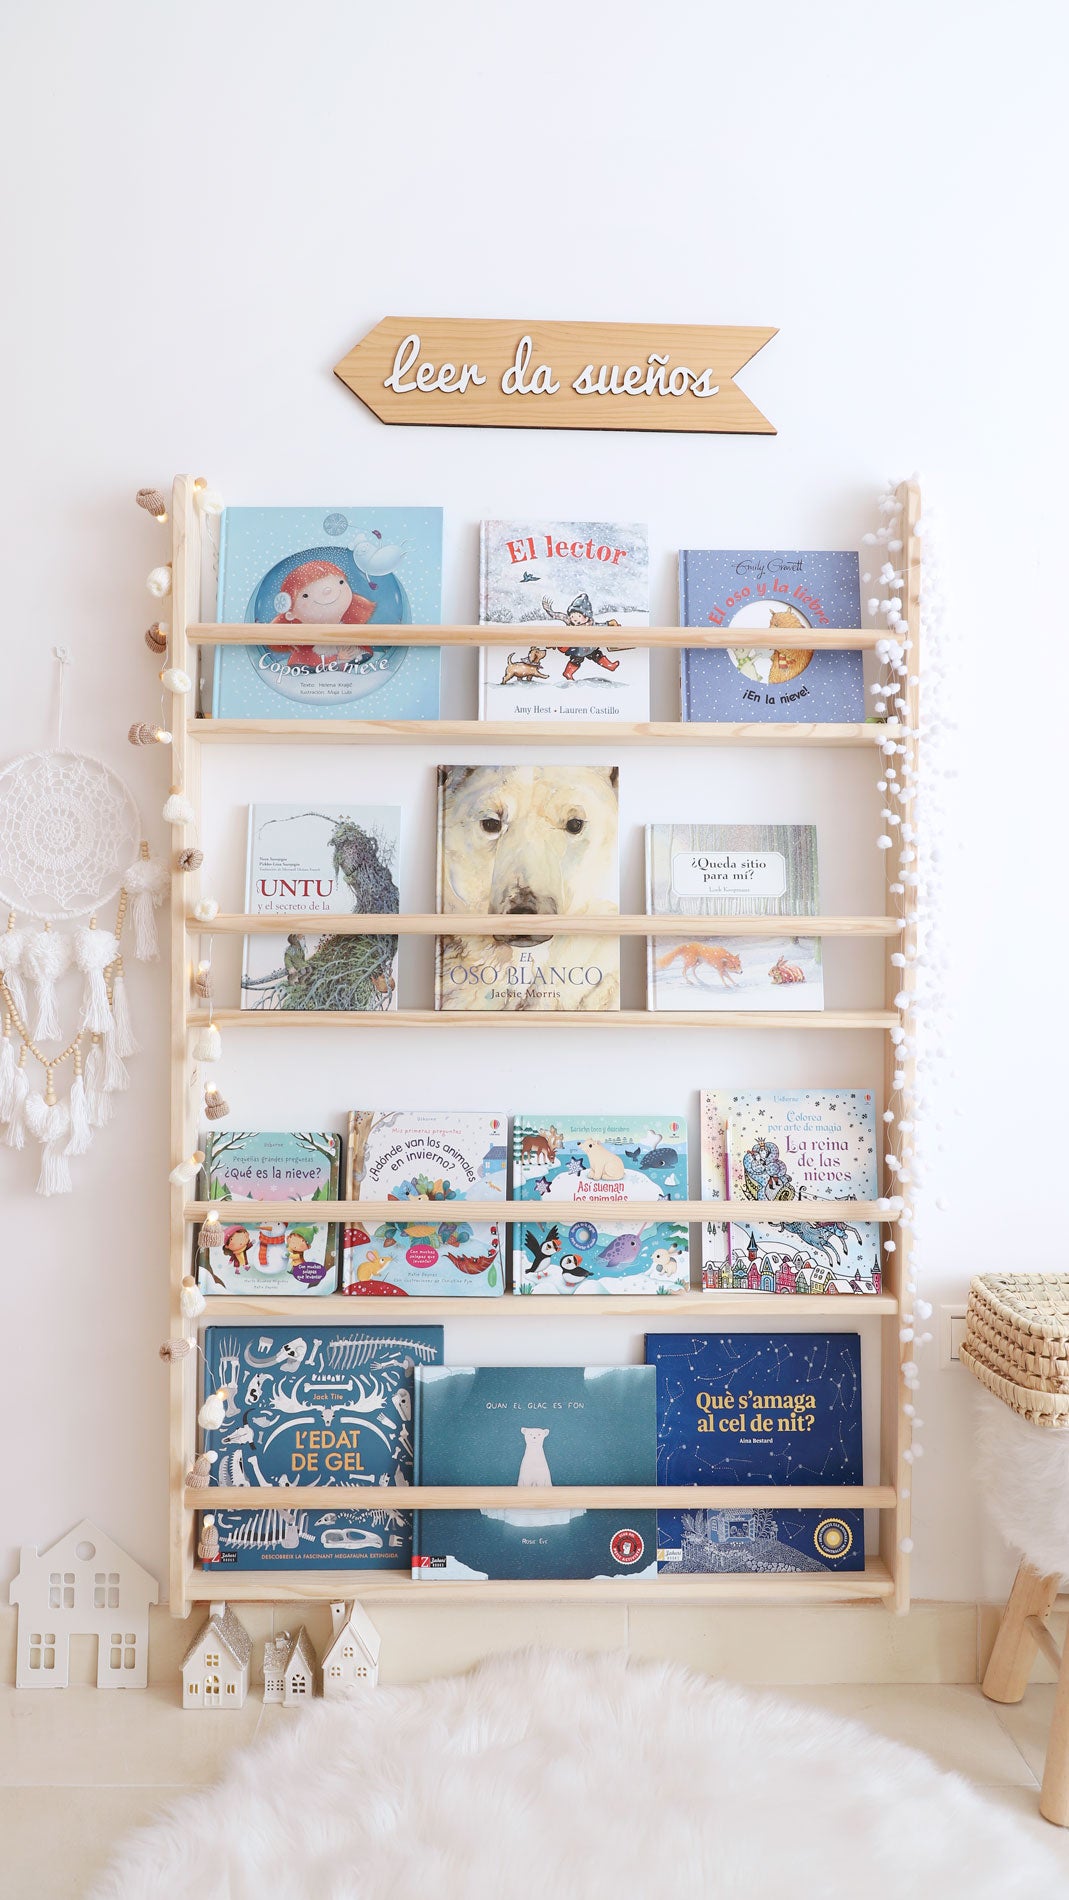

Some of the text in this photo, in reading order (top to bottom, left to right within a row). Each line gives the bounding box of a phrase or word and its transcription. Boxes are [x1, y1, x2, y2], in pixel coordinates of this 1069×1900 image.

[383, 334, 720, 398] leer da sueños
[505, 535, 627, 566] El lector
[707, 578, 830, 626] El oso y la liebre
[258, 652, 389, 684] Copos de nieve
[742, 686, 810, 704] ¡En la nieve!
[514, 705, 620, 715] Amy Hest Lauren Castillo
[691, 856, 767, 871] ¿Queda sitio
[703, 869, 755, 883] para mí?
[256, 879, 333, 898] UNTU
[257, 901, 330, 911] y el secreto de la
[519, 952, 534, 963] EL
[450, 965, 603, 986] OSO BLANCO
[490, 988, 561, 999] Jackie Morris
[786, 1110, 822, 1122] Colorea
[767, 1122, 842, 1134] por arte de magia
[786, 1135, 849, 1154] La reina
[369, 1136, 476, 1183] ¿Adónde van los animales
[390, 1148, 456, 1172] en invierno?
[797, 1152, 841, 1167] de las
[224, 1166, 321, 1180] ¿Qué es la nieve?
[804, 1167, 852, 1181] nieves
[577, 1181, 625, 1194] Así suenan
[486, 1402, 508, 1410] QUAN
[513, 1402, 522, 1410] EL
[527, 1402, 548, 1410] GLAC
[567, 1402, 585, 1410] FON
[695, 1390, 817, 1414] Què s'amaga
[697, 1412, 816, 1432] al cel de nit?
[295, 1430, 361, 1449] L'EDAT
[291, 1452, 365, 1472] DE GEL
